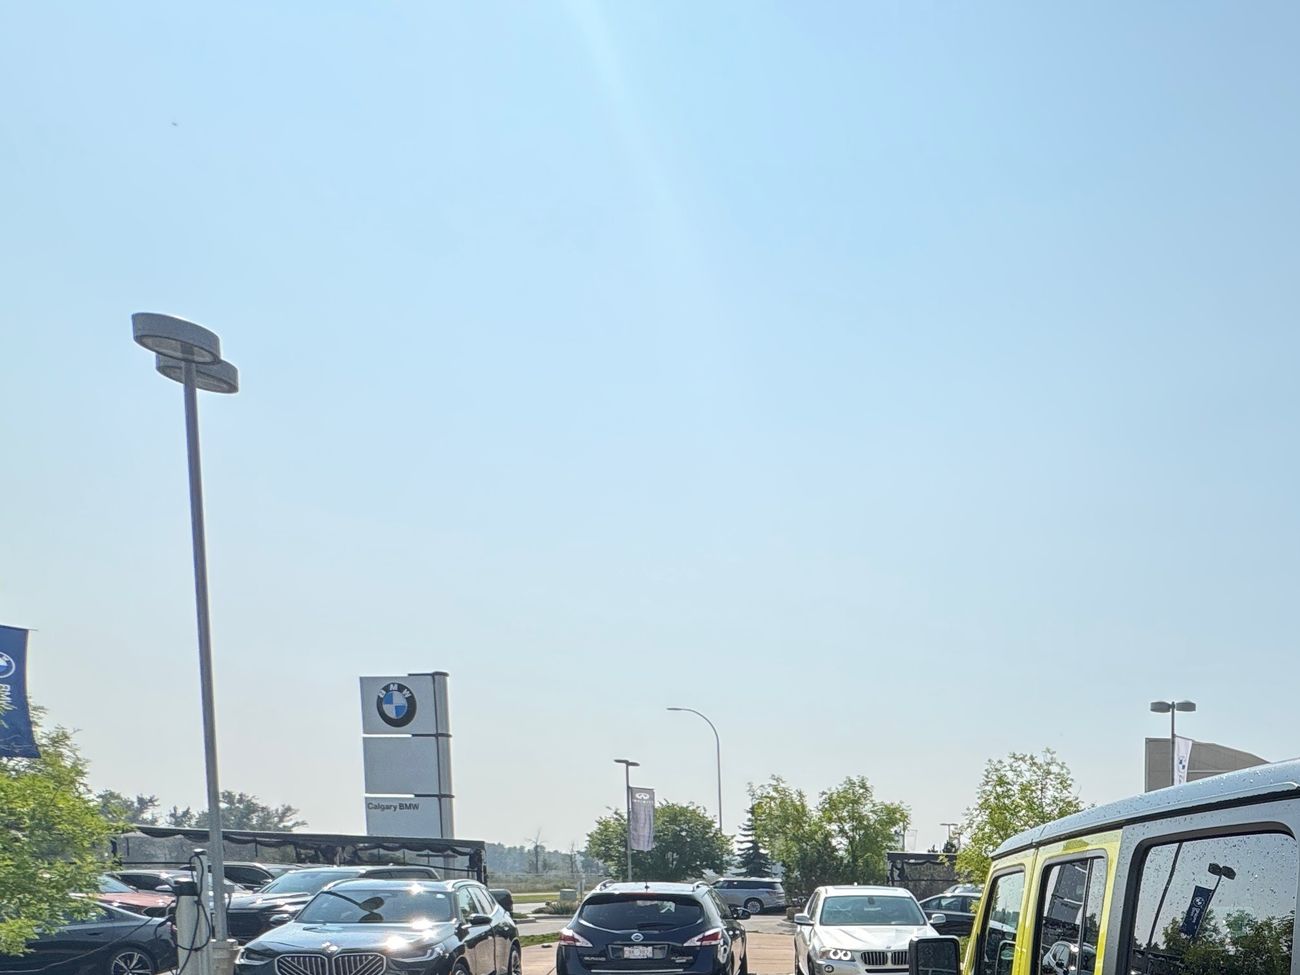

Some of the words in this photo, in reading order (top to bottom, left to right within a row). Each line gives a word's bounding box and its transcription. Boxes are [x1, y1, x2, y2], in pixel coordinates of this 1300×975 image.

[378, 683, 411, 698] BMW
[367, 802, 397, 812] Calgary
[399, 802, 419, 811] BMW
